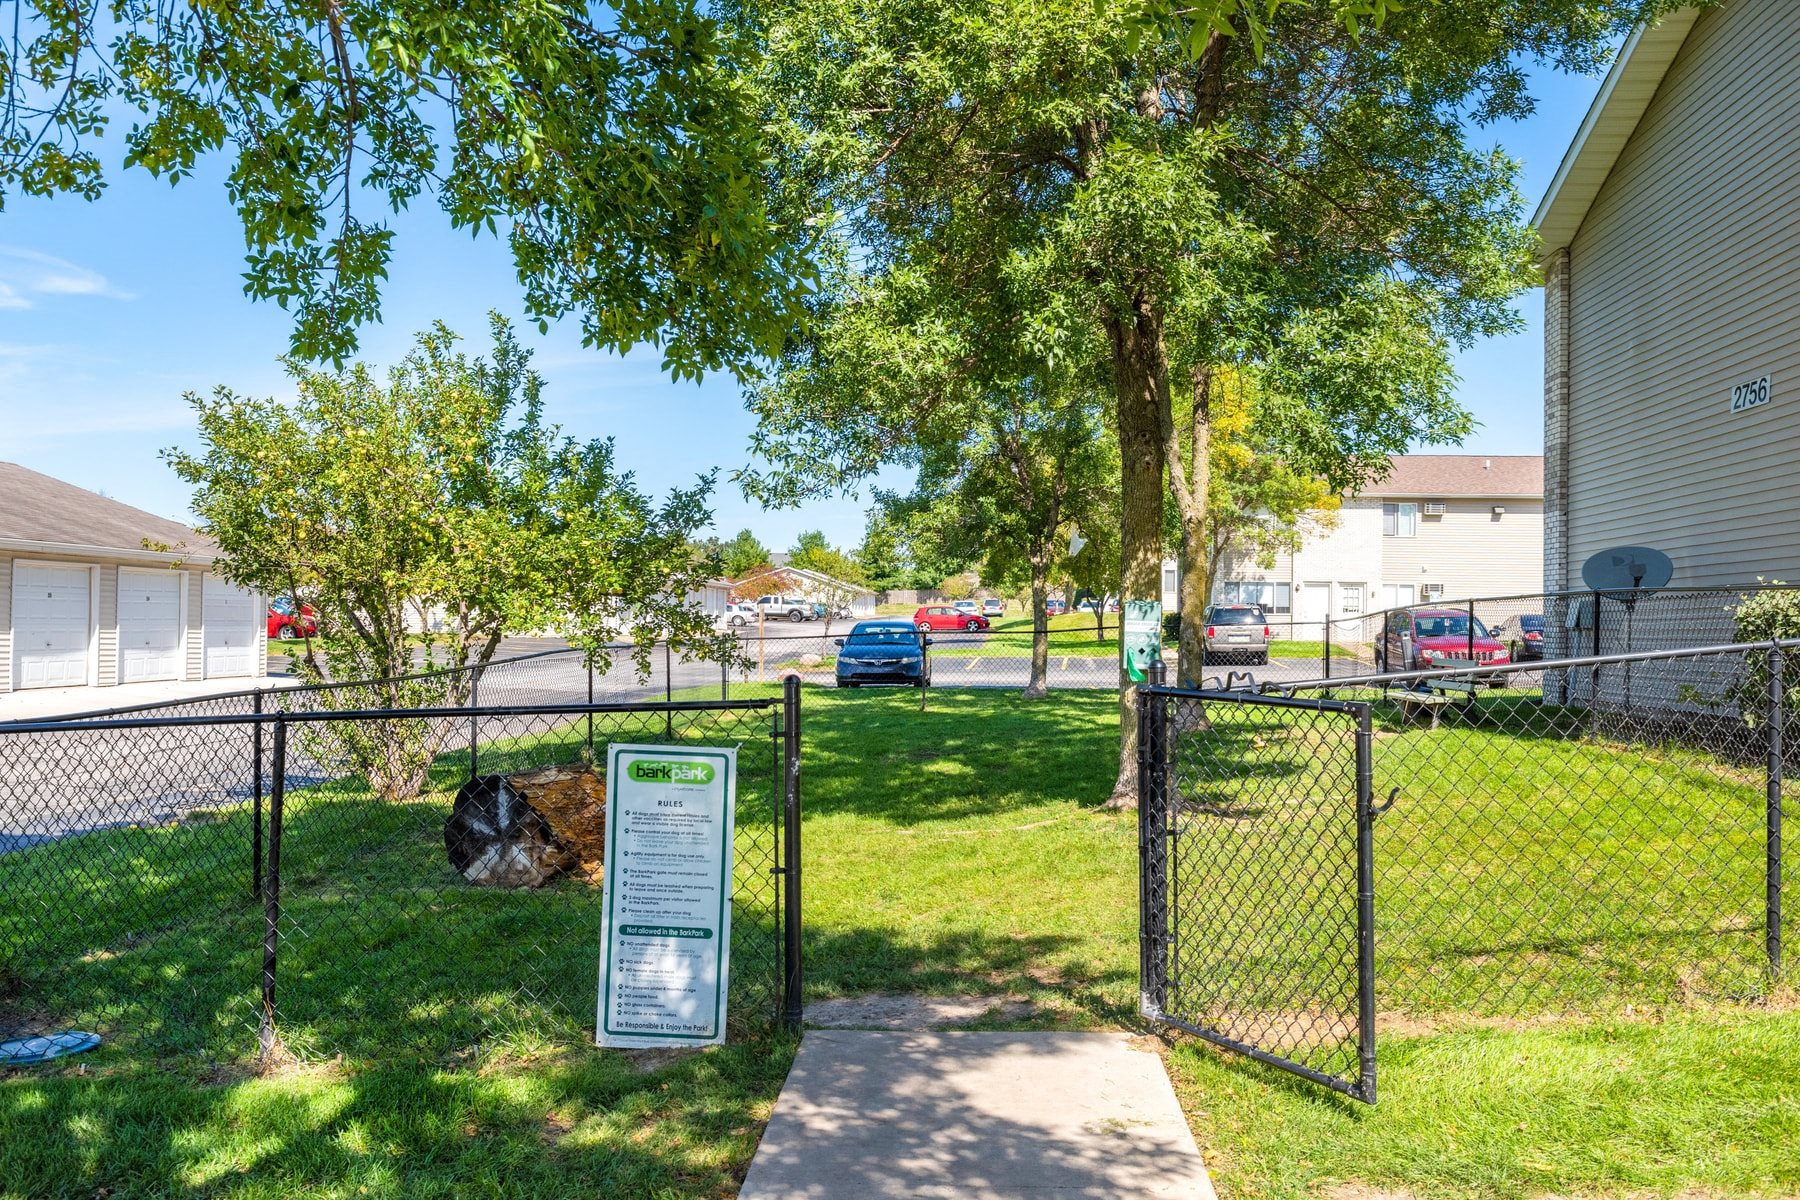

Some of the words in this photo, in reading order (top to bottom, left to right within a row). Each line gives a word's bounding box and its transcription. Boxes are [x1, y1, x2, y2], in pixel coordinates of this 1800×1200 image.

[1734, 377, 1768, 410] 2756
[638, 927, 662, 935] allowed
[679, 929, 704, 937] BarkPark
[625, 1022, 660, 1030] Responsible
